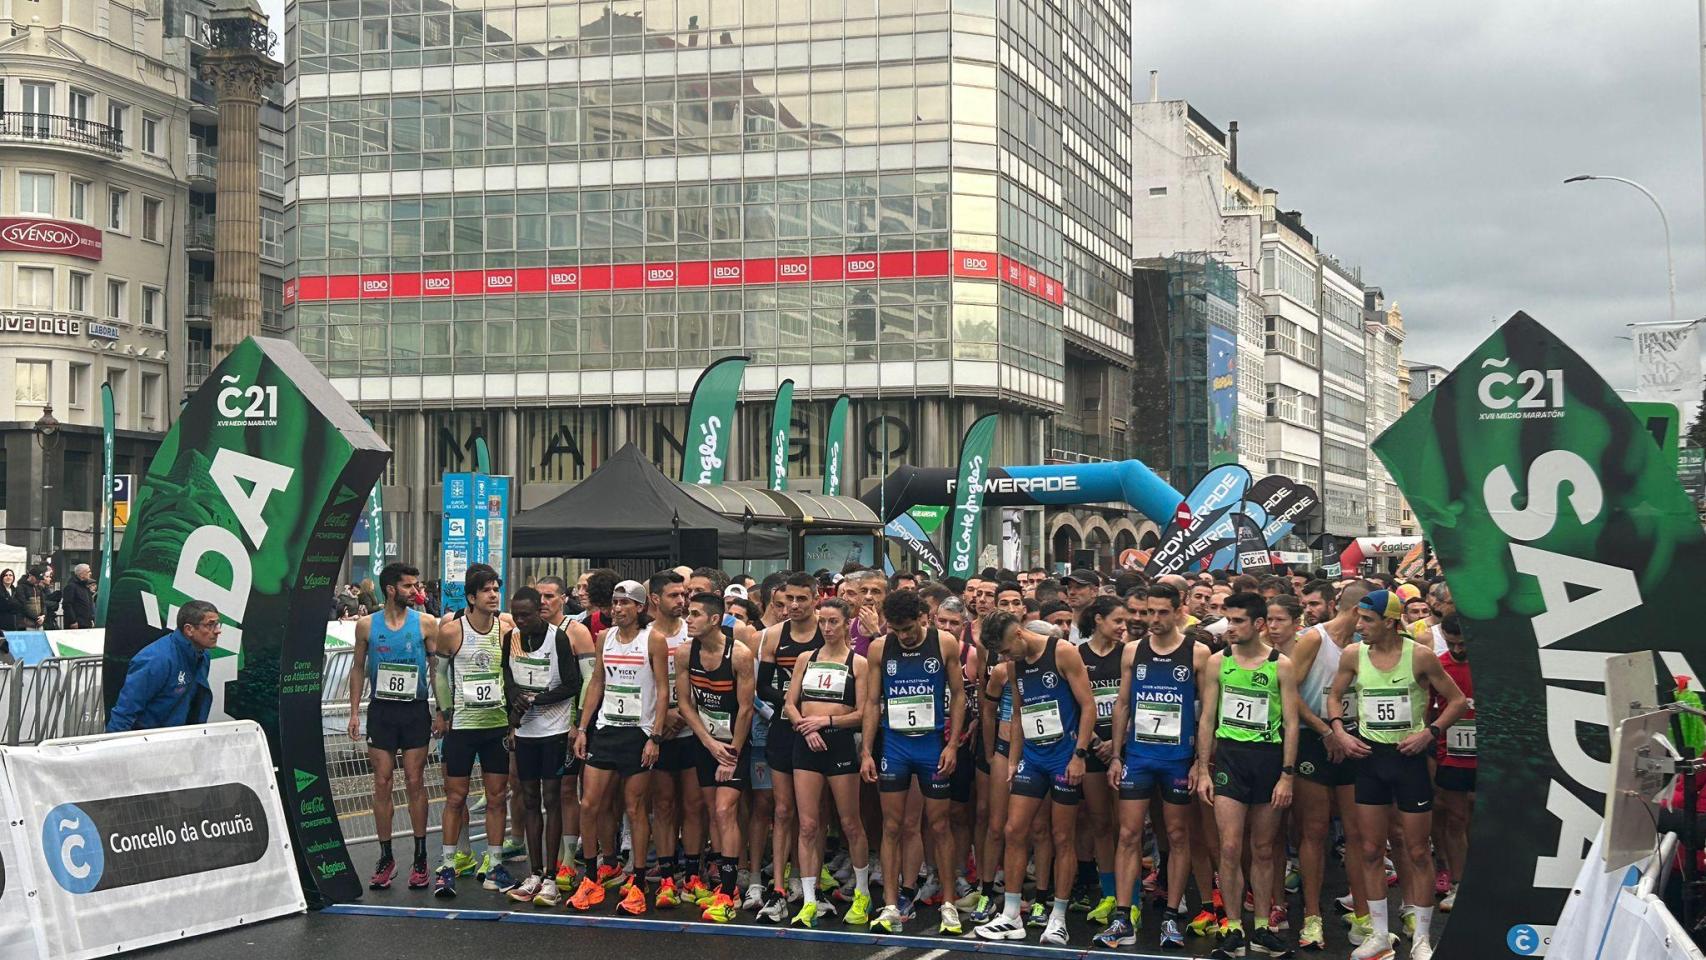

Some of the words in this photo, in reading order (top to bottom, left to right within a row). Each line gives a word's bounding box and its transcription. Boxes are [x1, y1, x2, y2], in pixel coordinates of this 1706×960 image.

[10, 228, 73, 245] SVENSON
[783, 263, 808, 274] BDO
[850, 259, 876, 271] BDO
[965, 257, 988, 269] BDO
[553, 272, 577, 283] BDO
[649, 268, 674, 280] BDO
[715, 266, 740, 277] BDO
[366, 280, 388, 290] BDO
[427, 277, 450, 288] BDO
[490, 275, 513, 286] BDO
[90, 323, 119, 338] LABORAL
[1496, 411, 1522, 419] MEDIO
[1523, 410, 1565, 419] MARATÓN
[697, 415, 722, 485] nglés
[773, 429, 786, 491] nglés
[829, 441, 839, 497] nglés
[946, 476, 1077, 494] PWERADE
[956, 455, 984, 513] Inglés
[1262, 496, 1315, 541] WERADE
[955, 514, 975, 553] Corte
[953, 554, 969, 572] El
[294, 661, 311, 670] Corre
[283, 674, 292, 682] co
[389, 677, 405, 691] 68
[528, 671, 533, 685] 1
[817, 674, 832, 689] 14
[476, 685, 491, 700] 92
[889, 683, 935, 696] NARÓN
[1136, 691, 1183, 703] NARÓN
[618, 699, 624, 714] 3
[1236, 702, 1252, 720] 21
[1377, 703, 1395, 721] 55
[908, 710, 916, 727] 5
[1153, 717, 1161, 733] 7
[709, 723, 716, 736] 2
[1036, 718, 1044, 735] 6
[110, 825, 177, 854] Concello
[180, 822, 199, 843] da
[201, 814, 254, 840] Coruña
